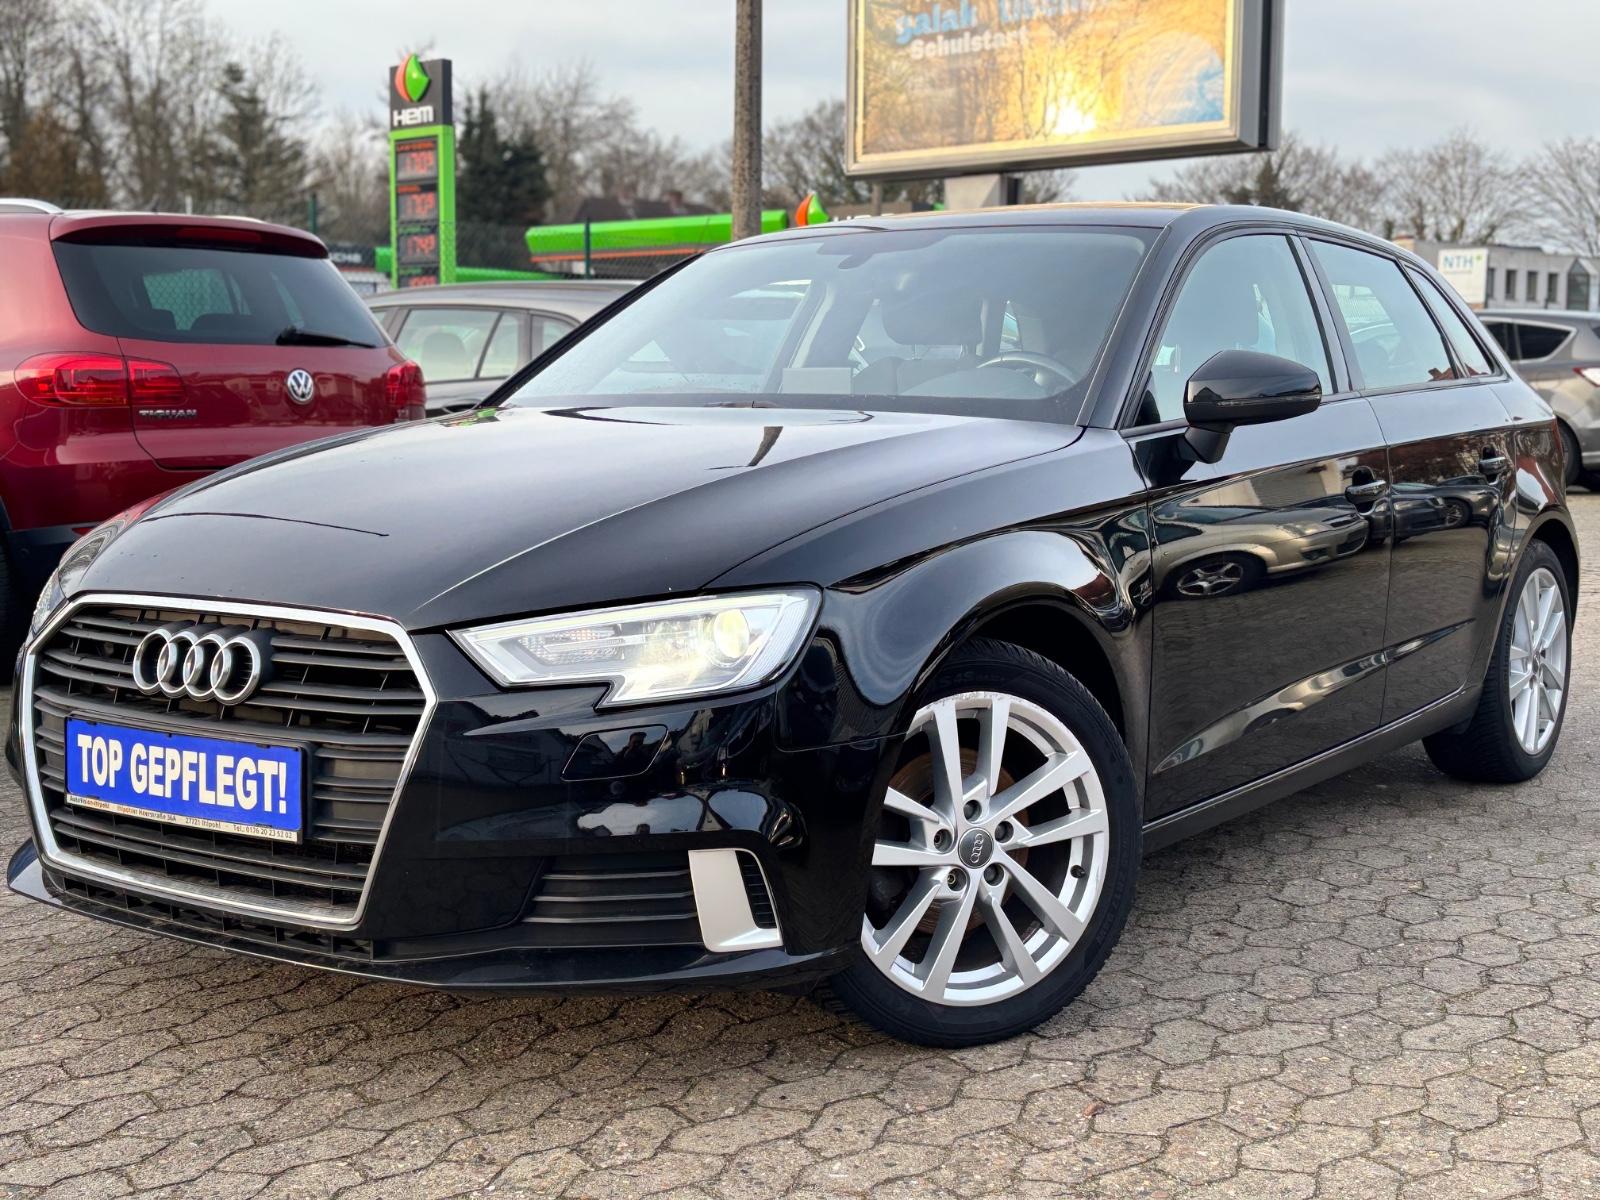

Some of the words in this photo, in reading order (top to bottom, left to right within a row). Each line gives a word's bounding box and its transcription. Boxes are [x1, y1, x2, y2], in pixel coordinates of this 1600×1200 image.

[909, 26, 1030, 61] Schulstart
[1443, 255, 1473, 268] NTH
[78, 734, 123, 788] TOP
[130, 743, 287, 814] GEPFLEGT!
